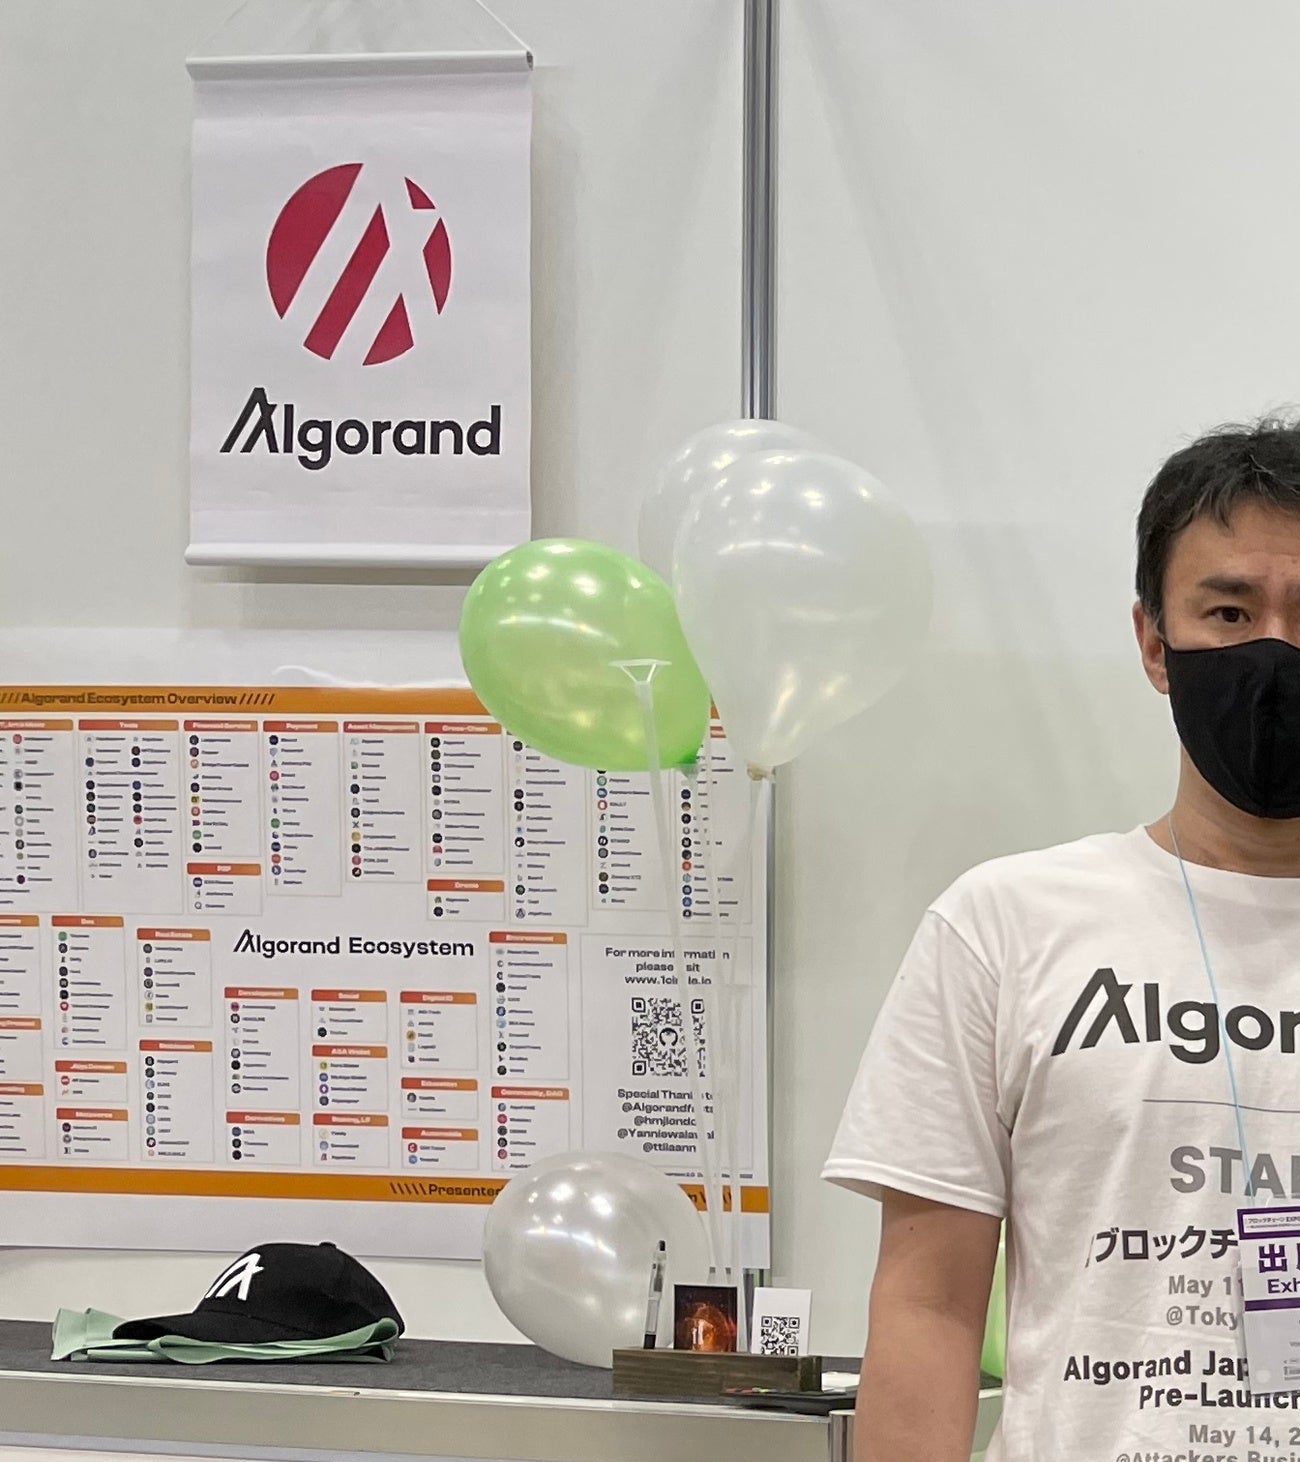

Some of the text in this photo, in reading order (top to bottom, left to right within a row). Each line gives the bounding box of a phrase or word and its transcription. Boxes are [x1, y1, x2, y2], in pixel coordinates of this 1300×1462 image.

[219, 387, 501, 471] Algorand
[87, 692, 165, 706] Ecosystem
[167, 692, 237, 705] Overview
[233, 929, 474, 960] Algorand Ecosystem
[628, 949, 659, 958] more
[636, 961, 674, 973] please
[617, 1088, 659, 1100] Special
[1095, 1225, 1239, 1263] ブロックチ
[1168, 1274, 1214, 1298] May
[1166, 1305, 1239, 1331] @Toky
[1063, 1350, 1192, 1386] Algorand
[1202, 1350, 1249, 1382] Jap
[1188, 1425, 1236, 1448] May
[1246, 1425, 1281, 1449] 14,
